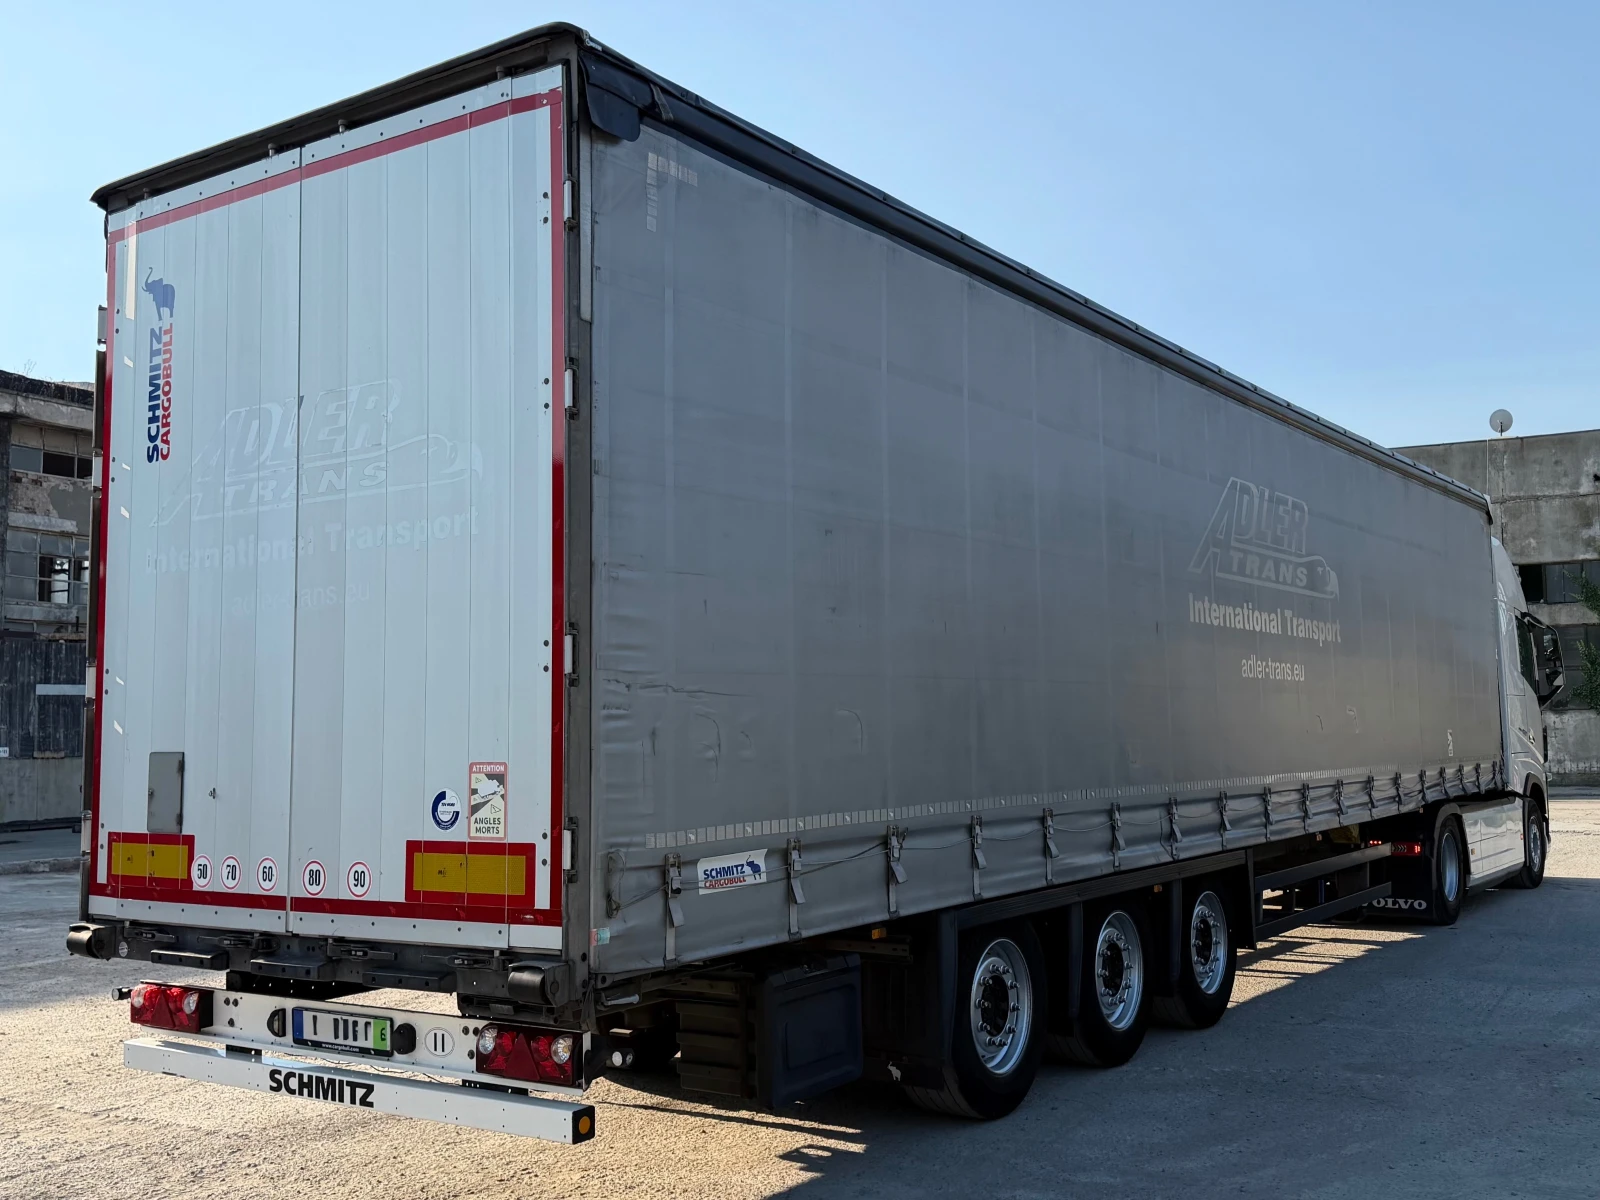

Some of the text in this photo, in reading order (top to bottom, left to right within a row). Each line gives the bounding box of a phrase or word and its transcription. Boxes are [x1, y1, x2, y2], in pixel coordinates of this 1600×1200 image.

[147, 326, 162, 463] SCHMITZ
[160, 323, 173, 461] CARGOBULL
[325, 505, 479, 551] Transport
[1187, 477, 1309, 574] ADLER
[1229, 550, 1308, 587] TRANS
[1188, 593, 1341, 646] International Transport
[1241, 654, 1305, 682] adler-trans.eu
[474, 817, 501, 825] ANGLES
[475, 826, 500, 834] MORTS
[197, 864, 207, 879] 50
[226, 864, 236, 880] 70
[262, 866, 273, 882] 60
[308, 869, 320, 886] 80
[353, 870, 366, 887] 90
[703, 864, 745, 880] SCHMITZ
[269, 1069, 374, 1108] SCHMITZ
